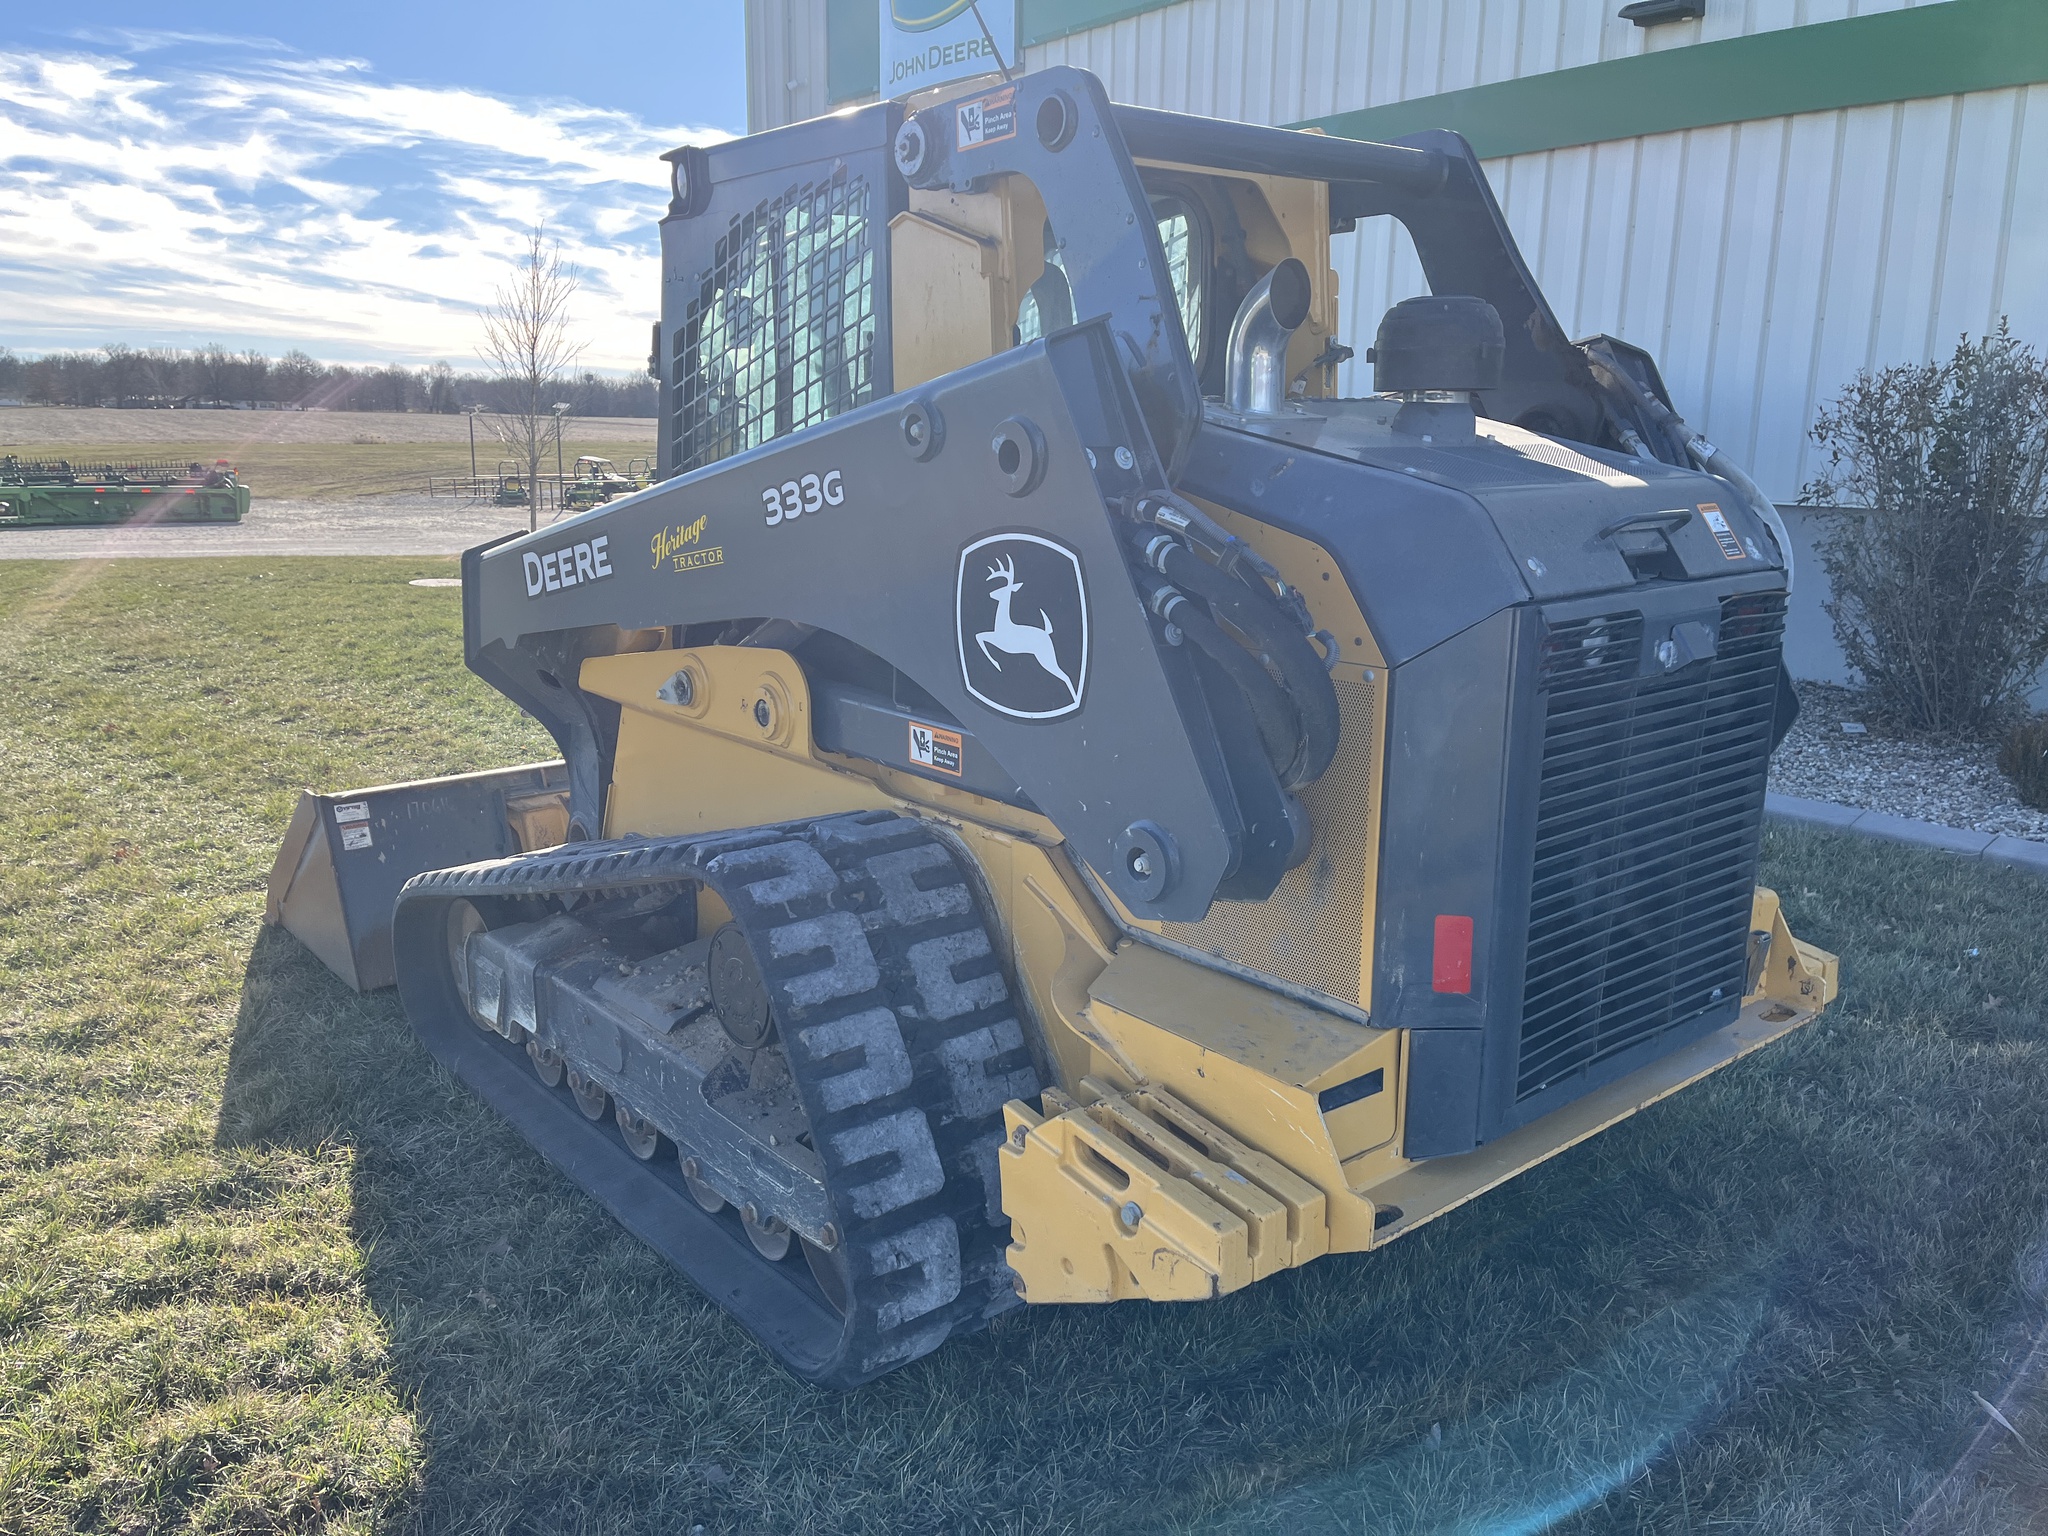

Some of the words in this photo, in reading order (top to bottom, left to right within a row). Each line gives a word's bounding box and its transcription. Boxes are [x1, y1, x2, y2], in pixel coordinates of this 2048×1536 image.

[889, 53, 925, 84] JOHN
[928, 36, 994, 70] DEERE
[985, 115, 999, 124] Pinch
[1000, 112, 1012, 120] Area
[997, 123, 1008, 131] Away
[762, 470, 844, 526] 333G
[651, 514, 708, 570] Heritage
[523, 535, 613, 597] DEERE
[673, 549, 724, 570] TRACTOR
[934, 746, 947, 756] Pinch
[947, 750, 958, 759] Area
[934, 755, 944, 764] Keep
[944, 758, 955, 767] Away
